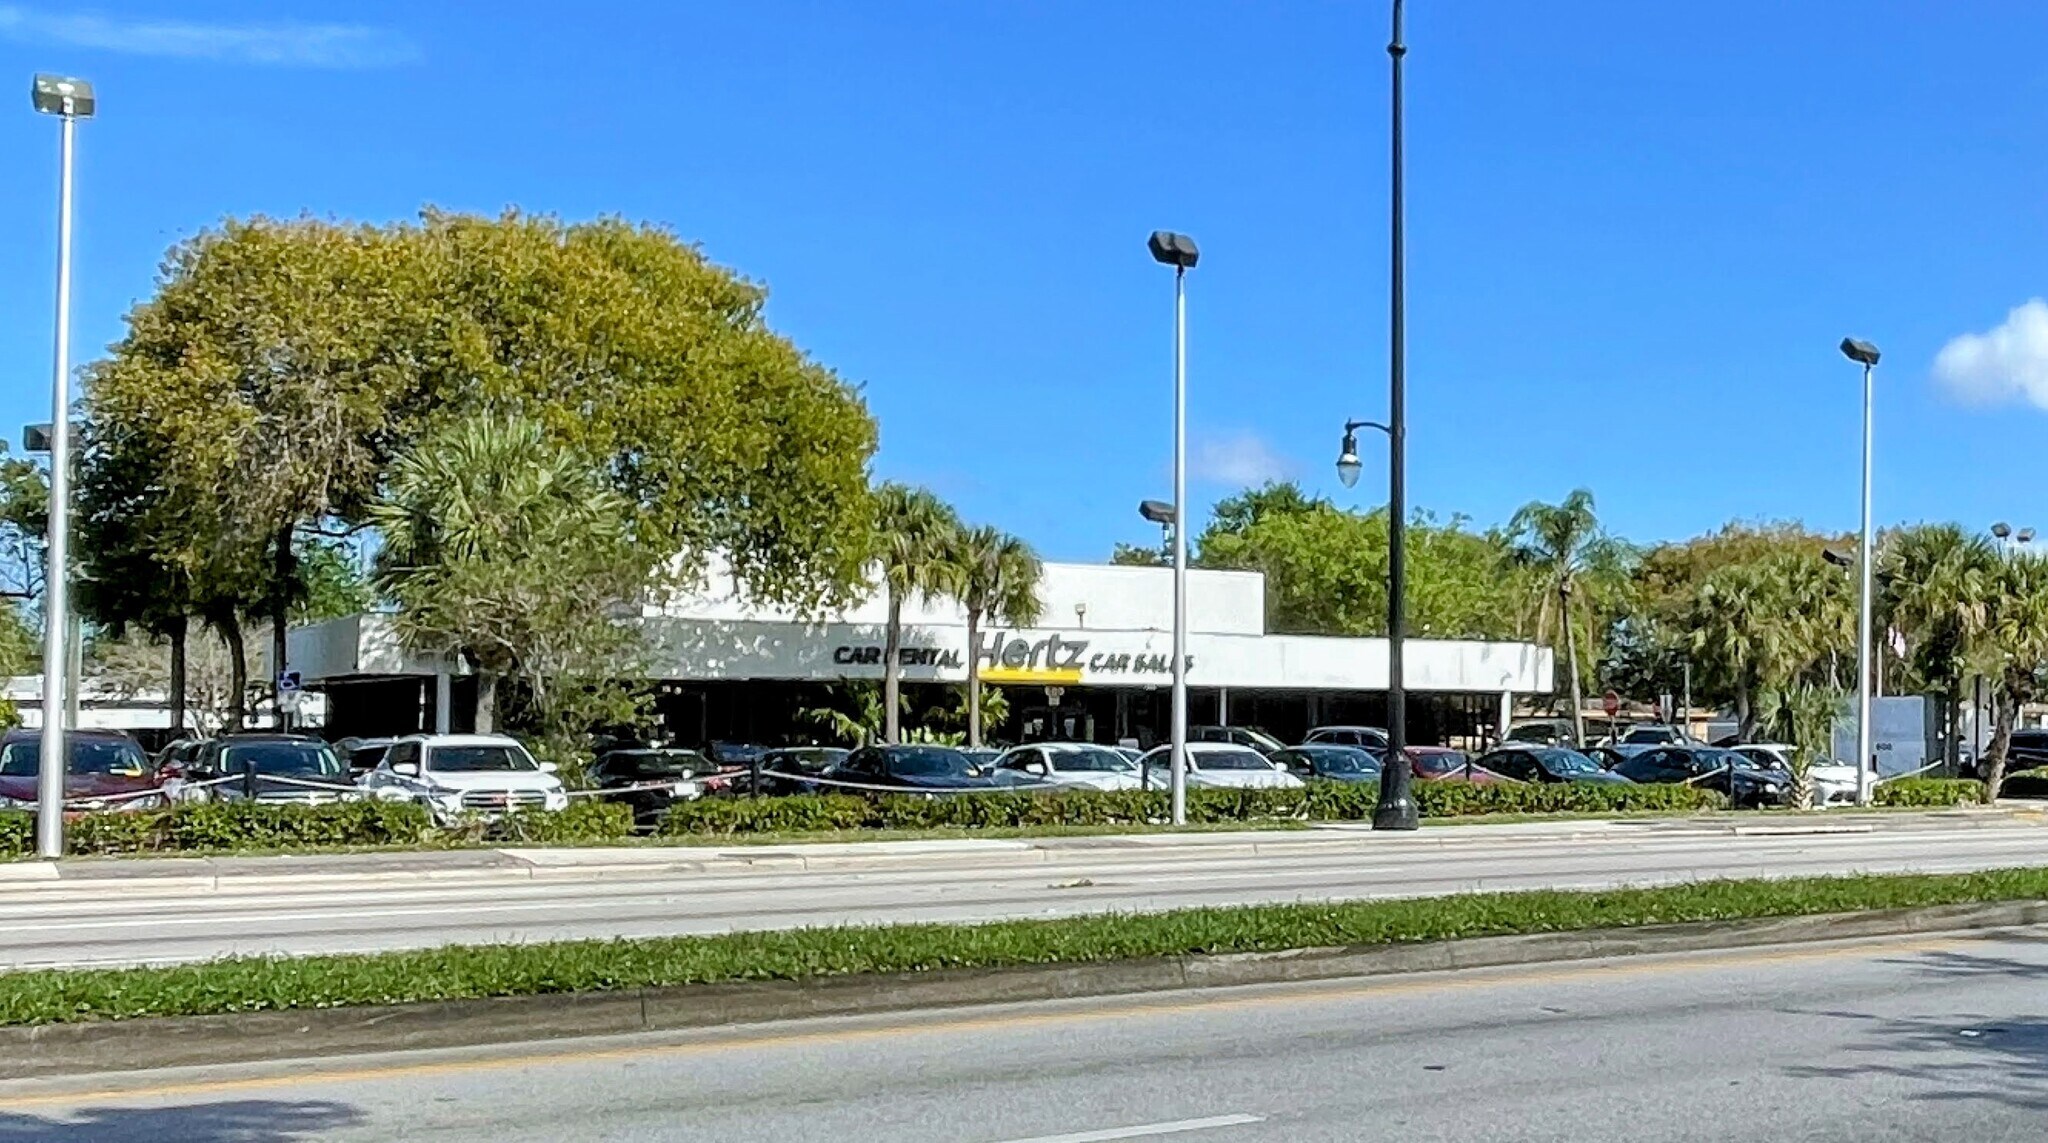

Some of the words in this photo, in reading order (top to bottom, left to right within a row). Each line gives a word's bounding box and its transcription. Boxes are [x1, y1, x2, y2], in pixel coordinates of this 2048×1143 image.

[834, 646, 881, 665] CAR
[884, 648, 964, 669] ENTAL
[978, 631, 1089, 668] Hertz
[1089, 654, 1131, 673] CAR
